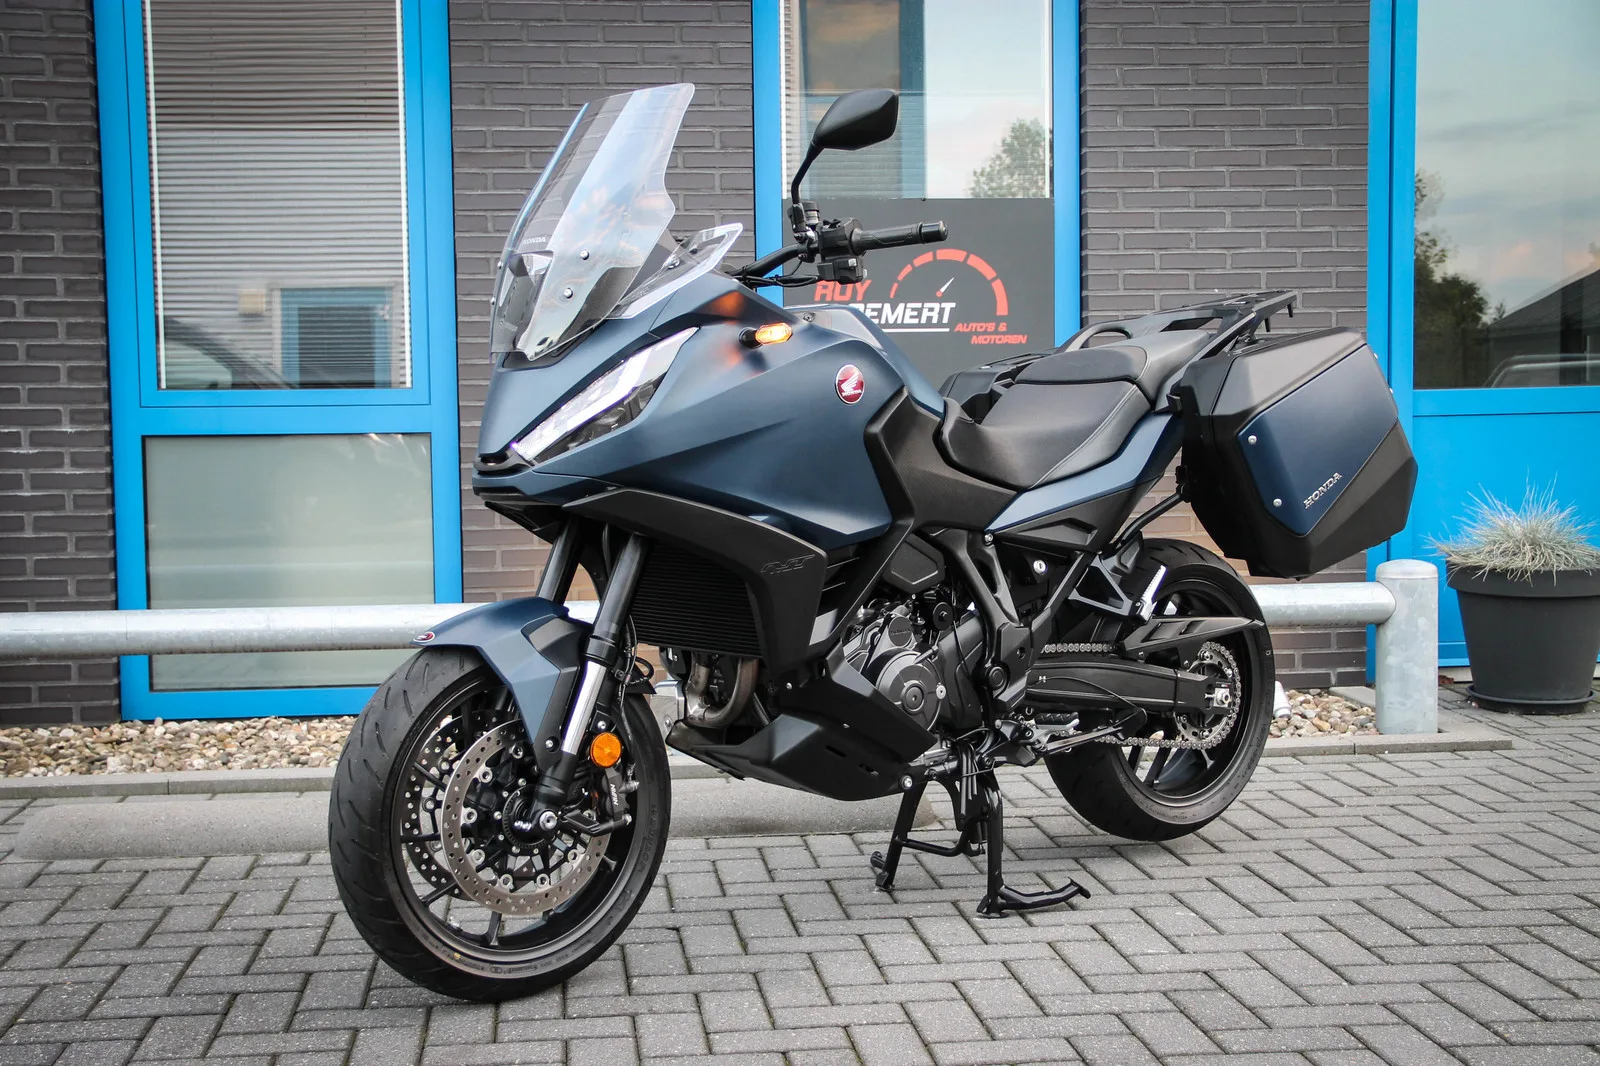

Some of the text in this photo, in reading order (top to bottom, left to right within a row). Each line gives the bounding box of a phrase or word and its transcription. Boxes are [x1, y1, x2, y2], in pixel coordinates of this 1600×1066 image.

[814, 279, 872, 302] ROY
[850, 302, 956, 324] EMERT
[954, 322, 1007, 332] AUTO'S &
[971, 334, 1027, 344] MOTOREN
[1303, 472, 1343, 509] HONDA
